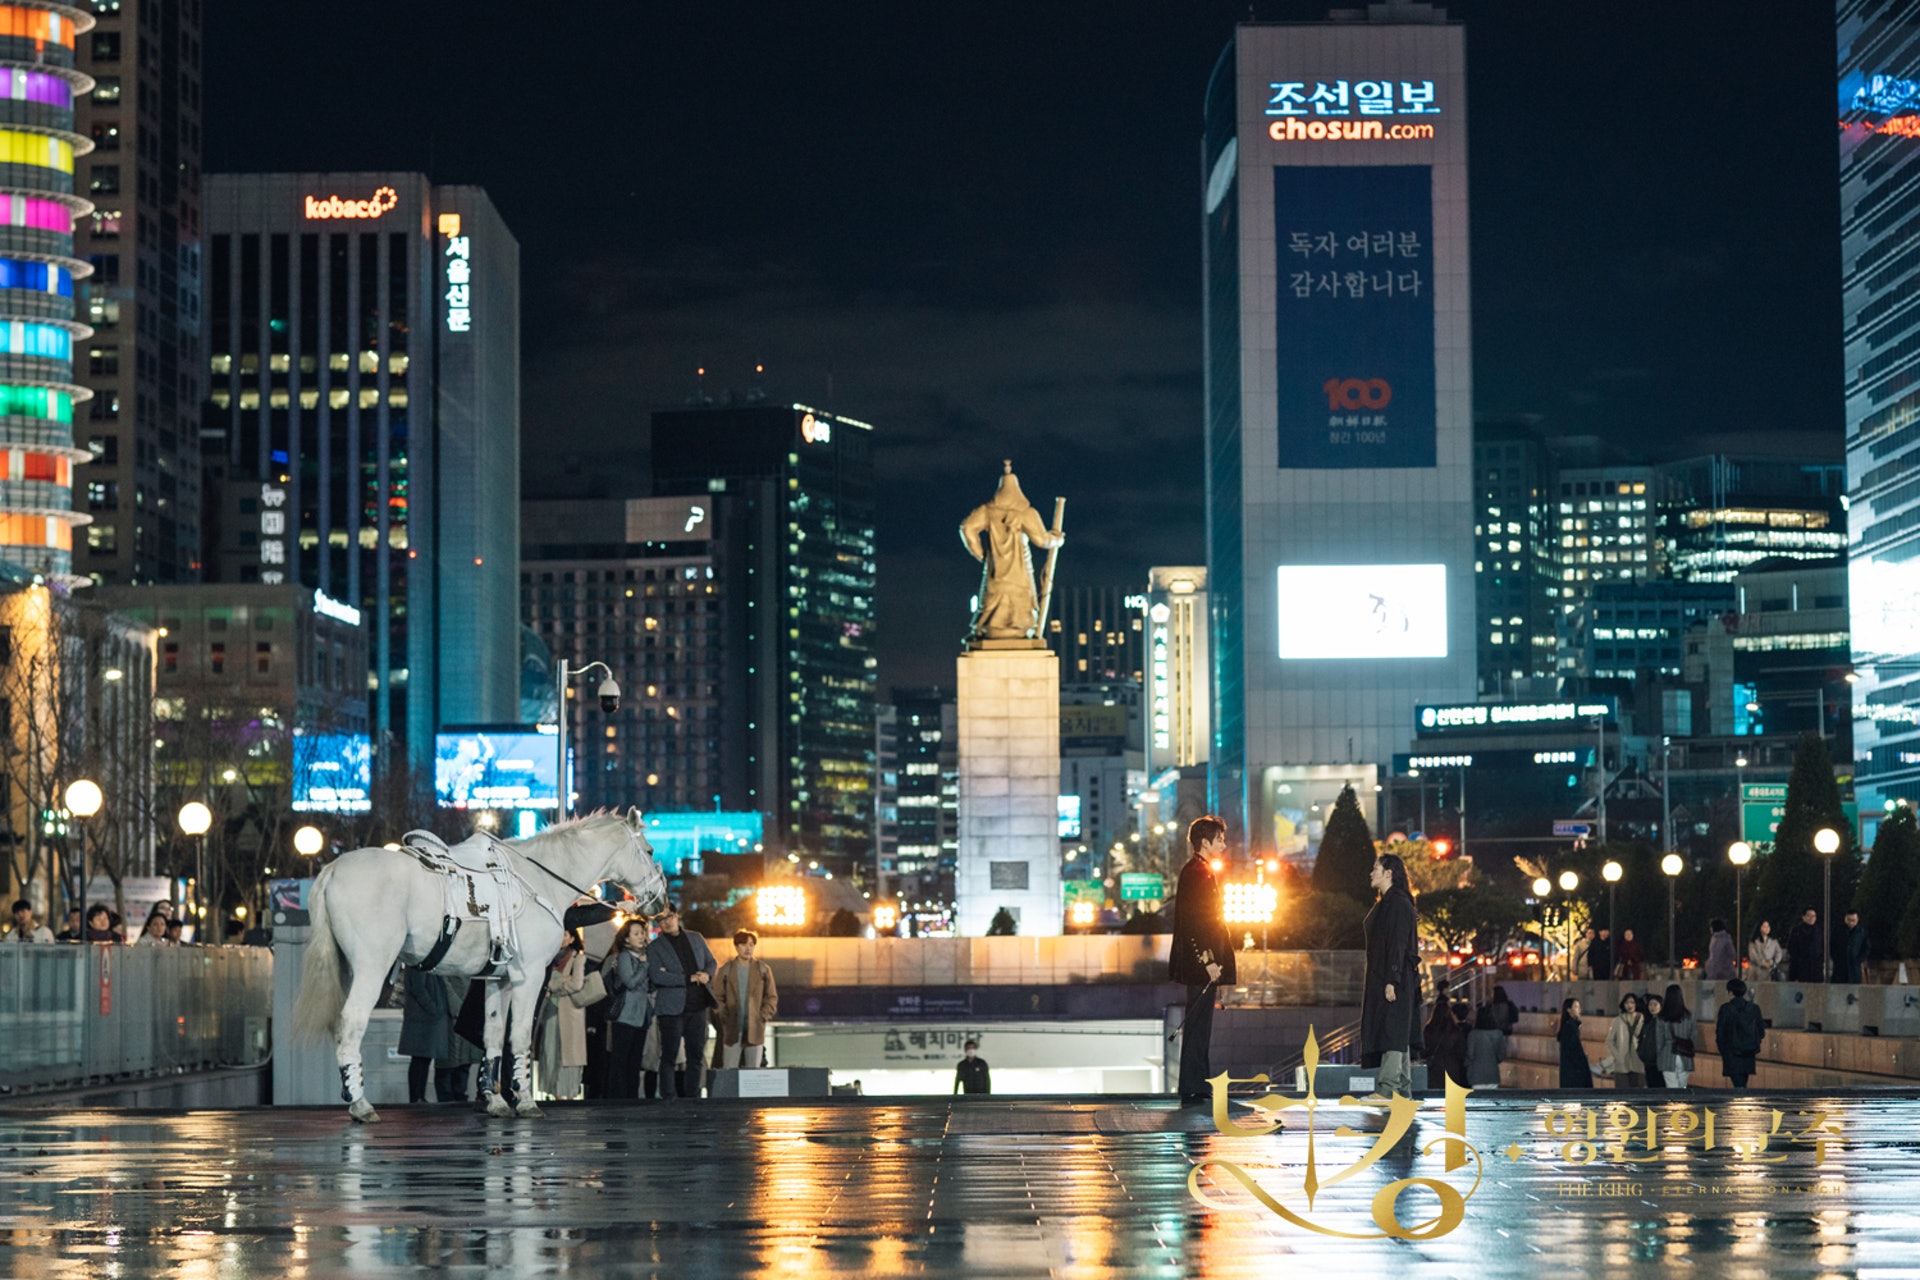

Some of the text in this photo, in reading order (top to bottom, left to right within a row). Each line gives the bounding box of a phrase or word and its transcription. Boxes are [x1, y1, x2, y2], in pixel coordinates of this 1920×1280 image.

[1264, 80, 1441, 115] 조선일보
[1269, 116, 1434, 140] chosun.com
[305, 195, 382, 219] kobaco
[1288, 230, 1422, 259] 독자 여러분
[445, 236, 471, 331] 서울신문
[1289, 270, 1423, 298] 감사합니다
[1322, 377, 1392, 410] 100
